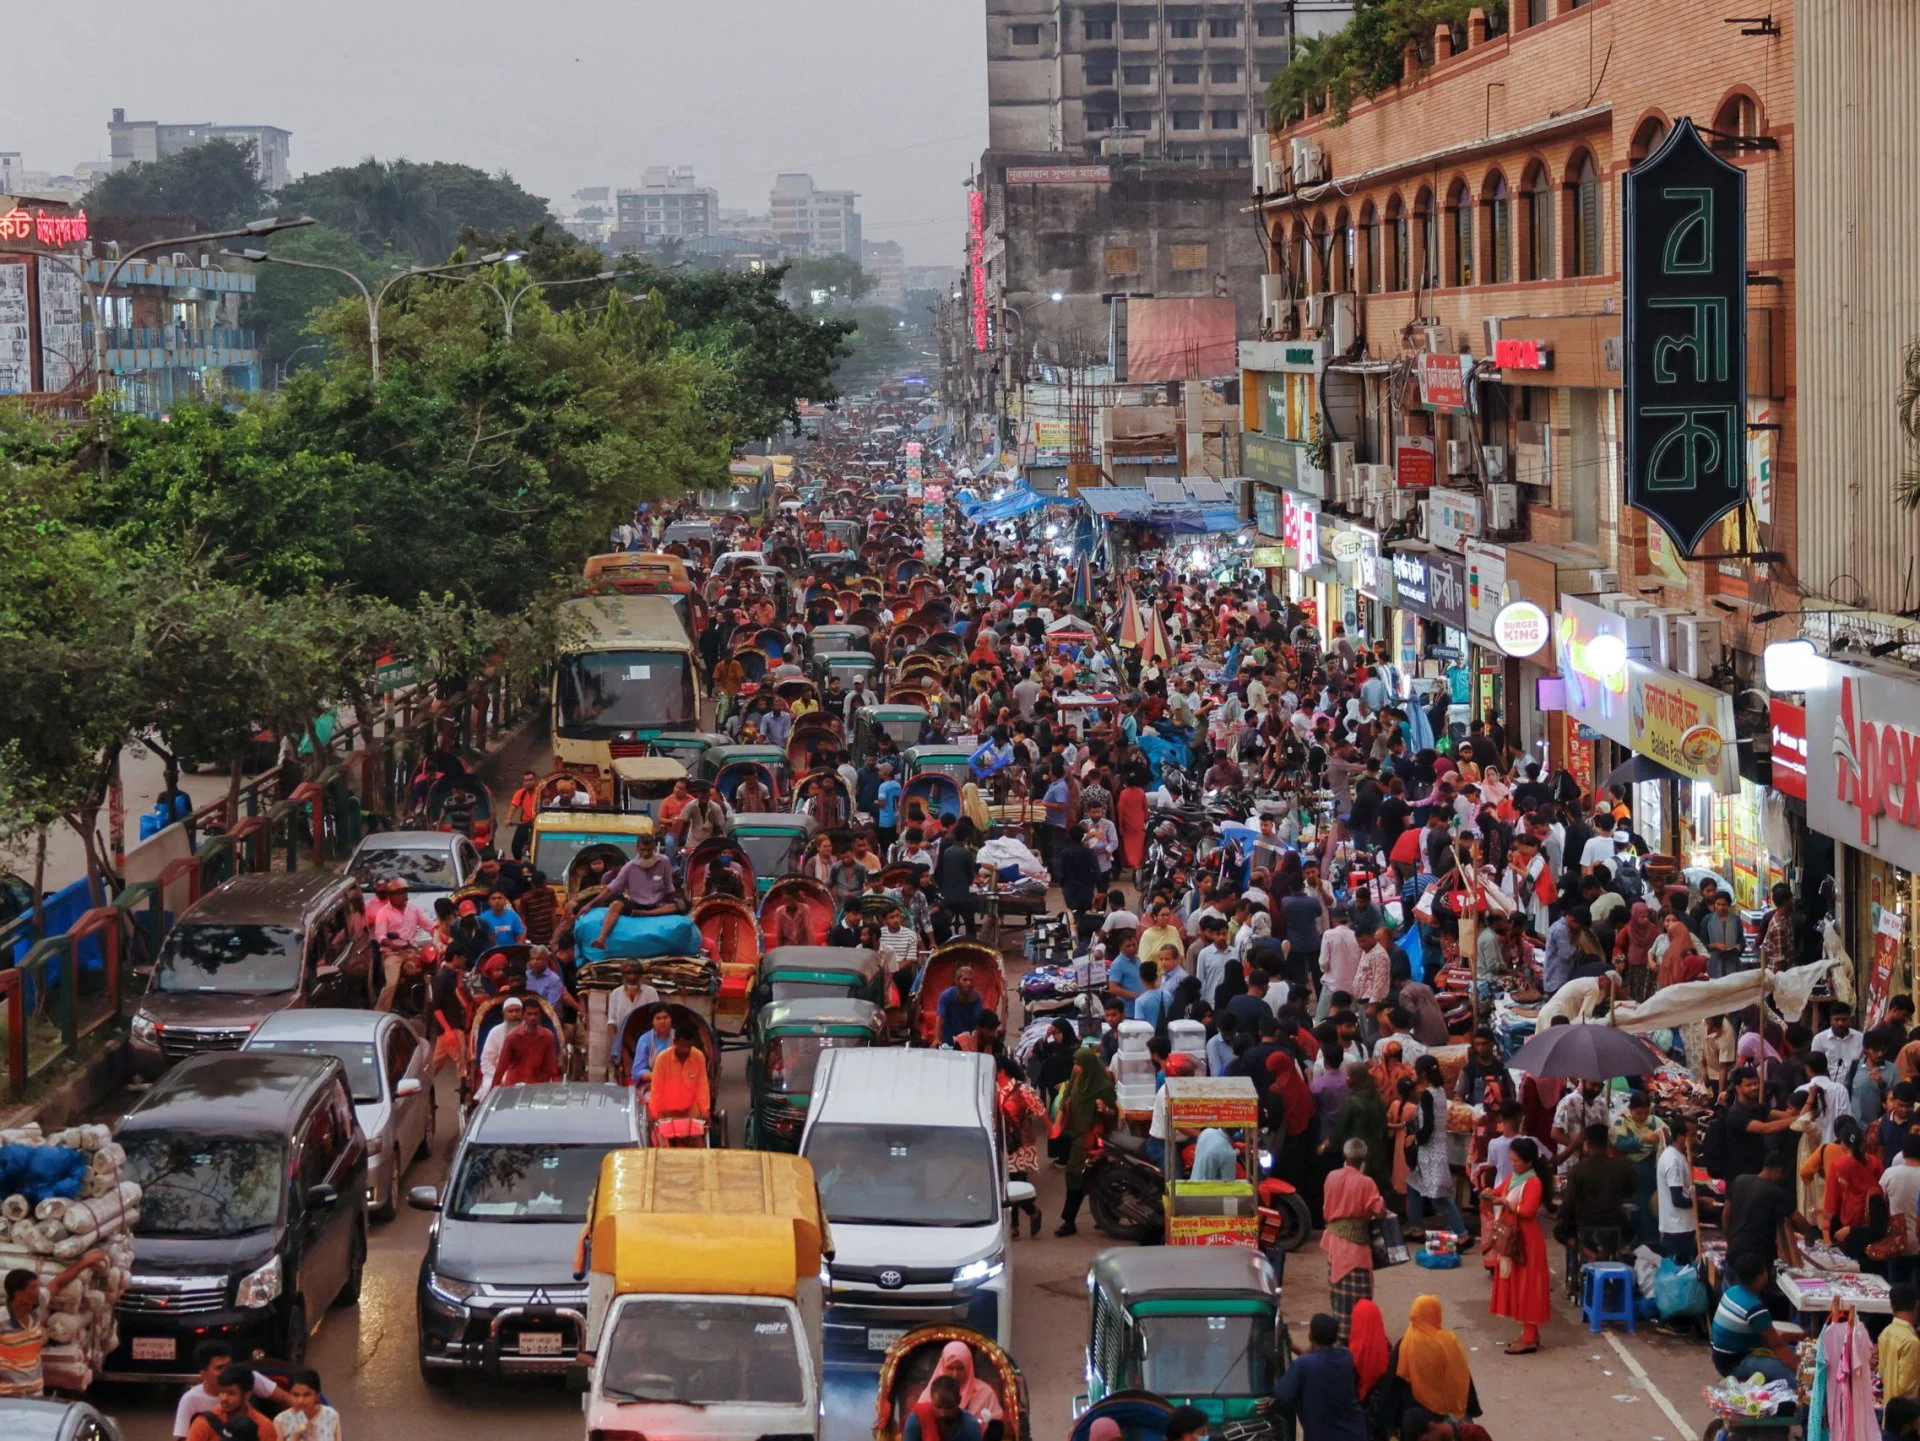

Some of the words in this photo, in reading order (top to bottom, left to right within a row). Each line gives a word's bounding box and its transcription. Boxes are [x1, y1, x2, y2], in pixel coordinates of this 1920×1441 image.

[1639, 187, 1738, 491] বলাকা
[1336, 541, 1361, 557] STEP
[1504, 620, 1538, 629] BURGER
[1504, 629, 1539, 640] KING
[1651, 731, 1670, 761] Balaka
[1833, 676, 1920, 846] Apex
